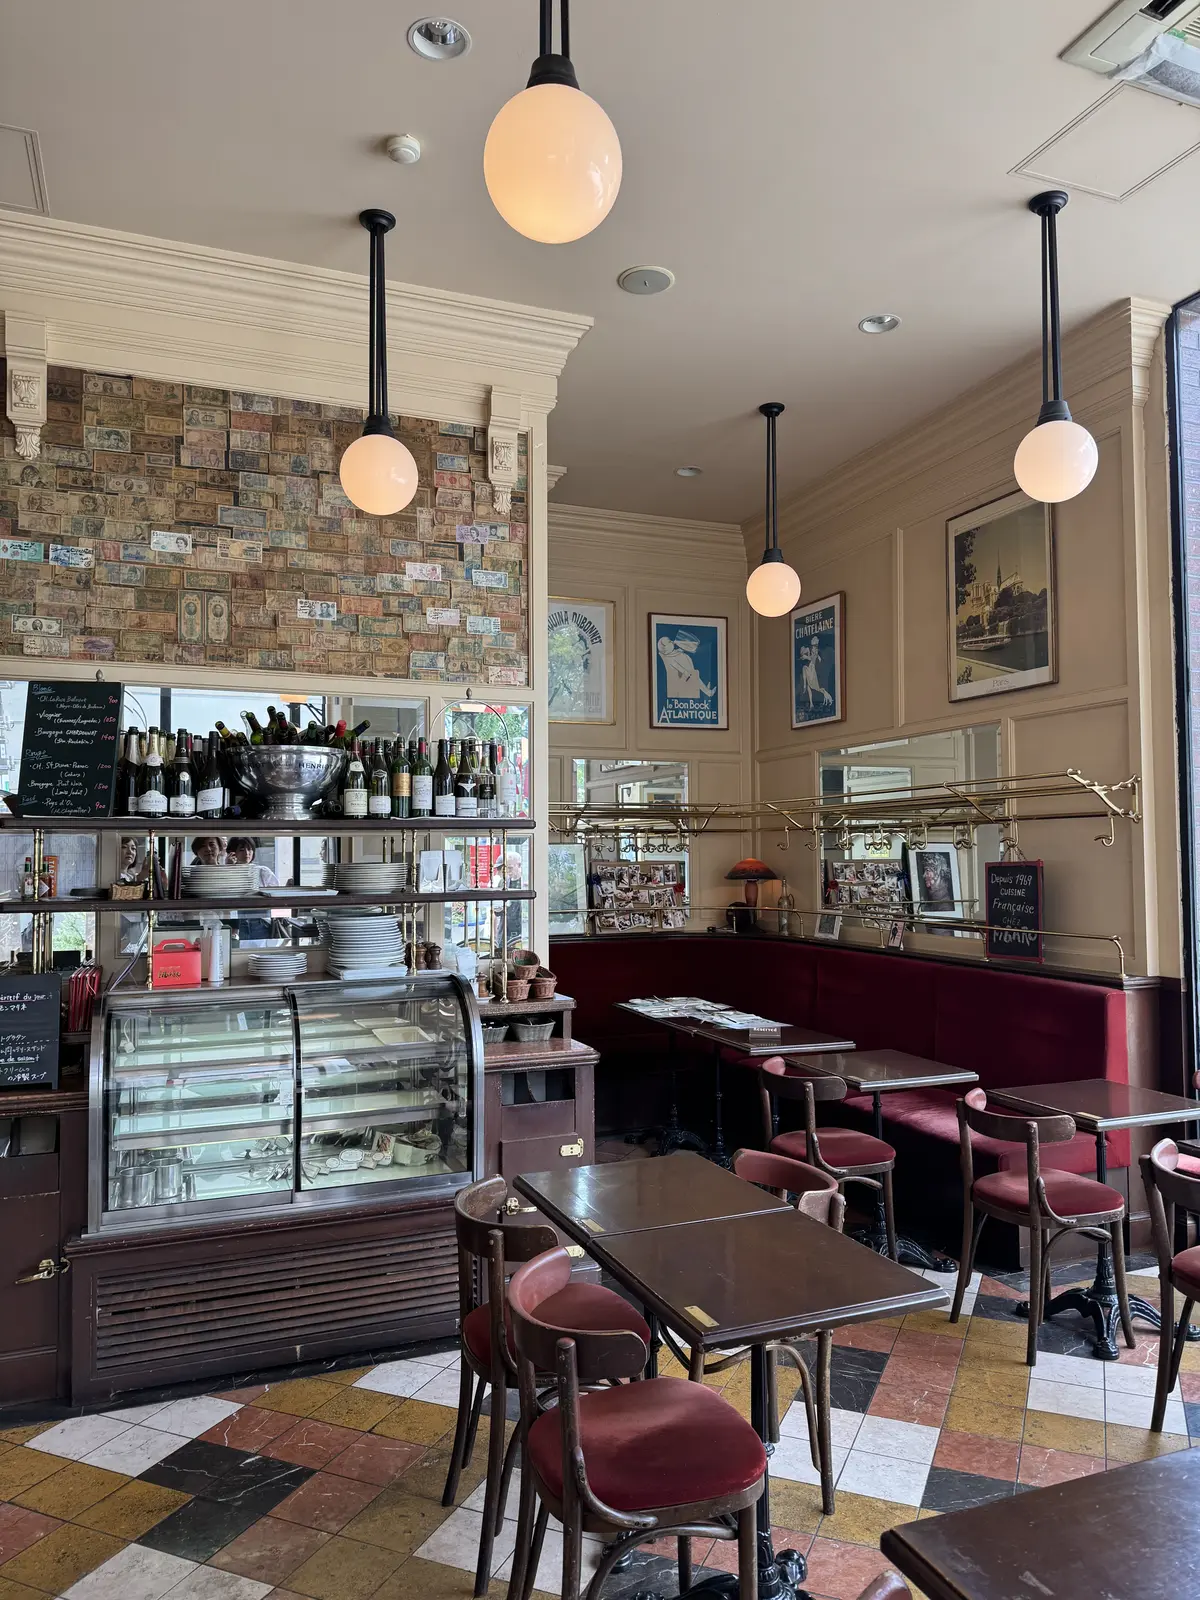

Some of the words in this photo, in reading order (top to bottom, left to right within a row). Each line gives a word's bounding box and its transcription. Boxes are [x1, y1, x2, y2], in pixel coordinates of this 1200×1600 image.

[571, 611, 602, 645] DUBONNET
[658, 705, 717, 724] ATLANTIQUE
[990, 872, 1013, 885] Depuis
[1015, 874, 1033, 886] 1969
[1000, 888, 1026, 897] CUISINE
[992, 898, 1035, 915] Française
